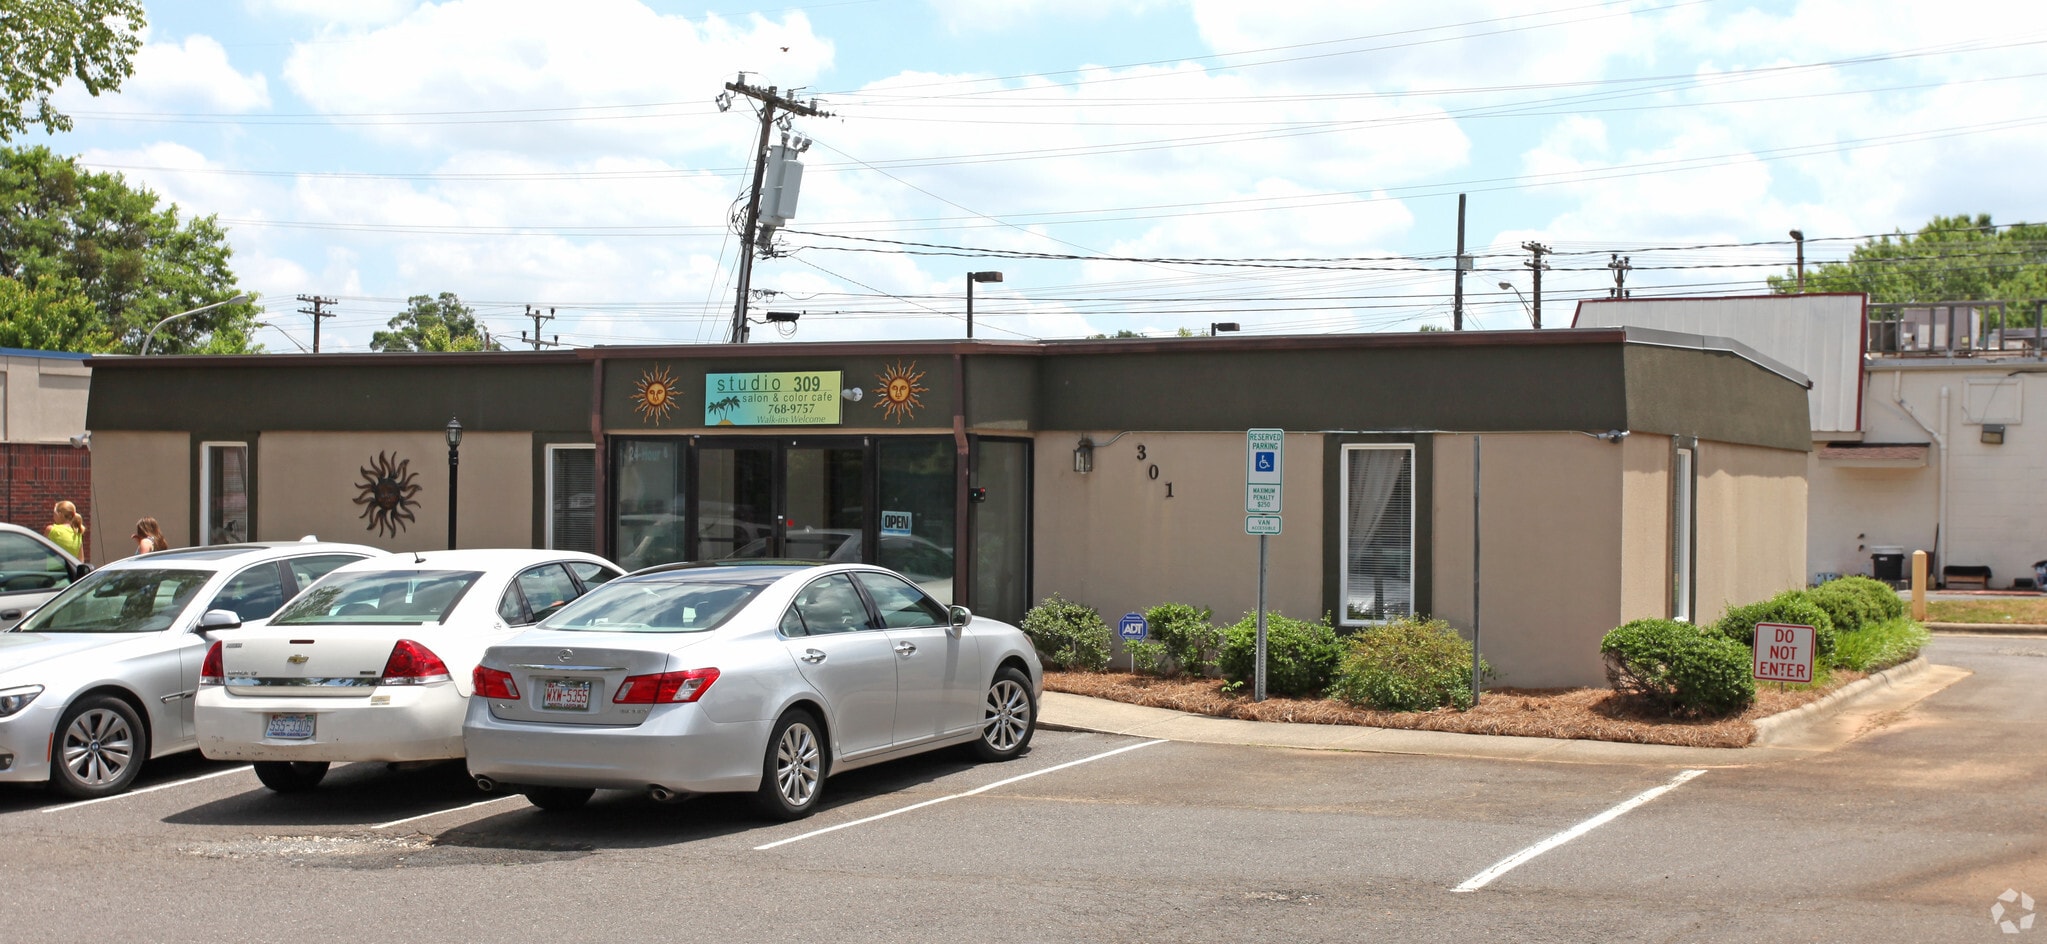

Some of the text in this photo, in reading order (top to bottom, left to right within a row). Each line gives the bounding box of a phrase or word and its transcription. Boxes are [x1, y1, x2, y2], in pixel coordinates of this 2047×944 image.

[717, 374, 821, 392] studio 309
[742, 391, 833, 403] salon & color cafe
[768, 403, 816, 415] 768-9757
[757, 414, 827, 425] Walk-ins Welcome
[1249, 432, 1281, 441] RESERVED
[1252, 442, 1279, 450] PARKING
[884, 514, 910, 529] OPEN
[1123, 623, 1144, 636] ADT
[1775, 628, 1795, 643] DO
[1769, 645, 1798, 660] NOT
[1759, 661, 1806, 678] ENTER
